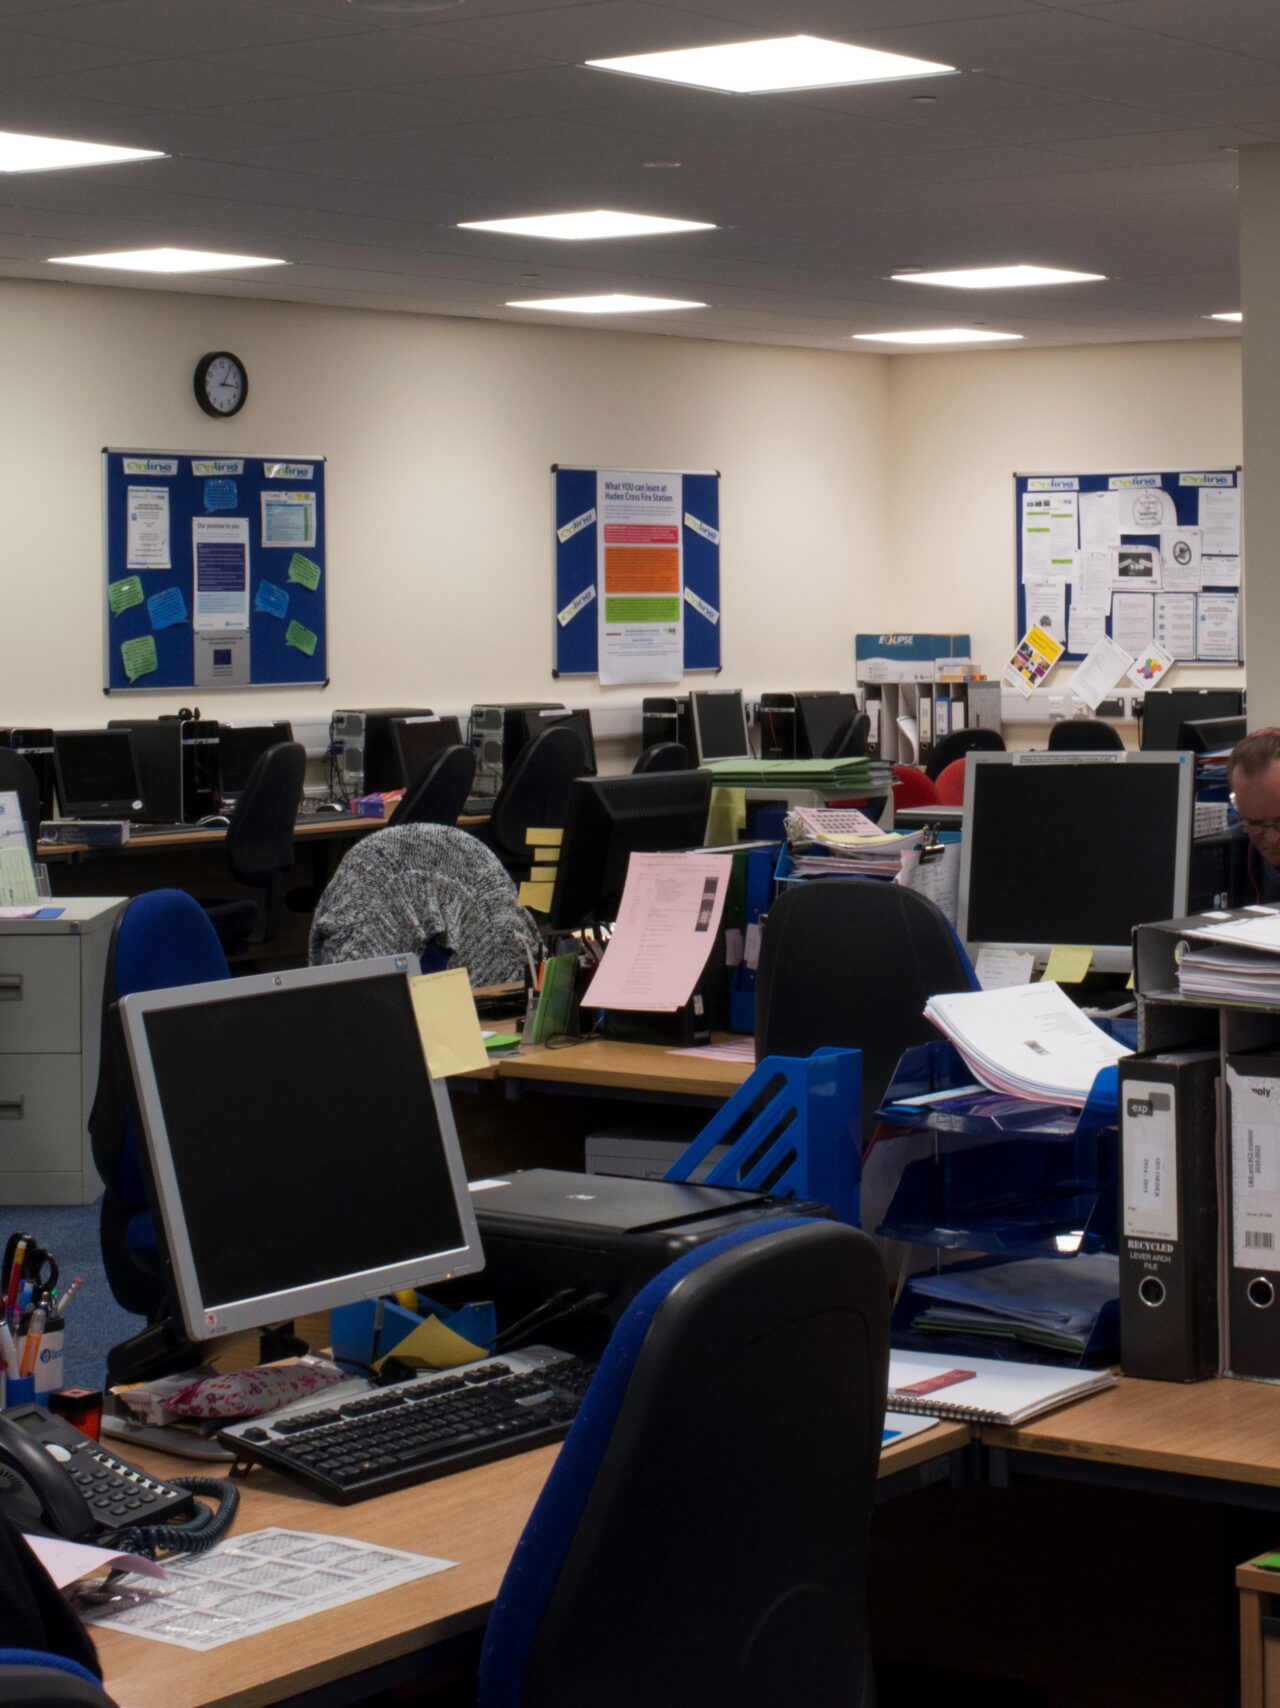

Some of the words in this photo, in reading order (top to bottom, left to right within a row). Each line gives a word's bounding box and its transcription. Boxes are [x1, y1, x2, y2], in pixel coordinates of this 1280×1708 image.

[604, 482, 620, 491] What
[622, 482, 634, 492] YOU
[646, 483, 660, 492] learn
[605, 492, 624, 500] Haden
[625, 492, 640, 501] Cross
[641, 493, 652, 502] Fire
[652, 494, 673, 502] Station
[1128, 1240, 1174, 1253] RECYCLED
[1130, 1252, 1151, 1261] LEVER
[1152, 1254, 1171, 1263] ARCH
[1144, 1262, 1158, 1271] FILE
